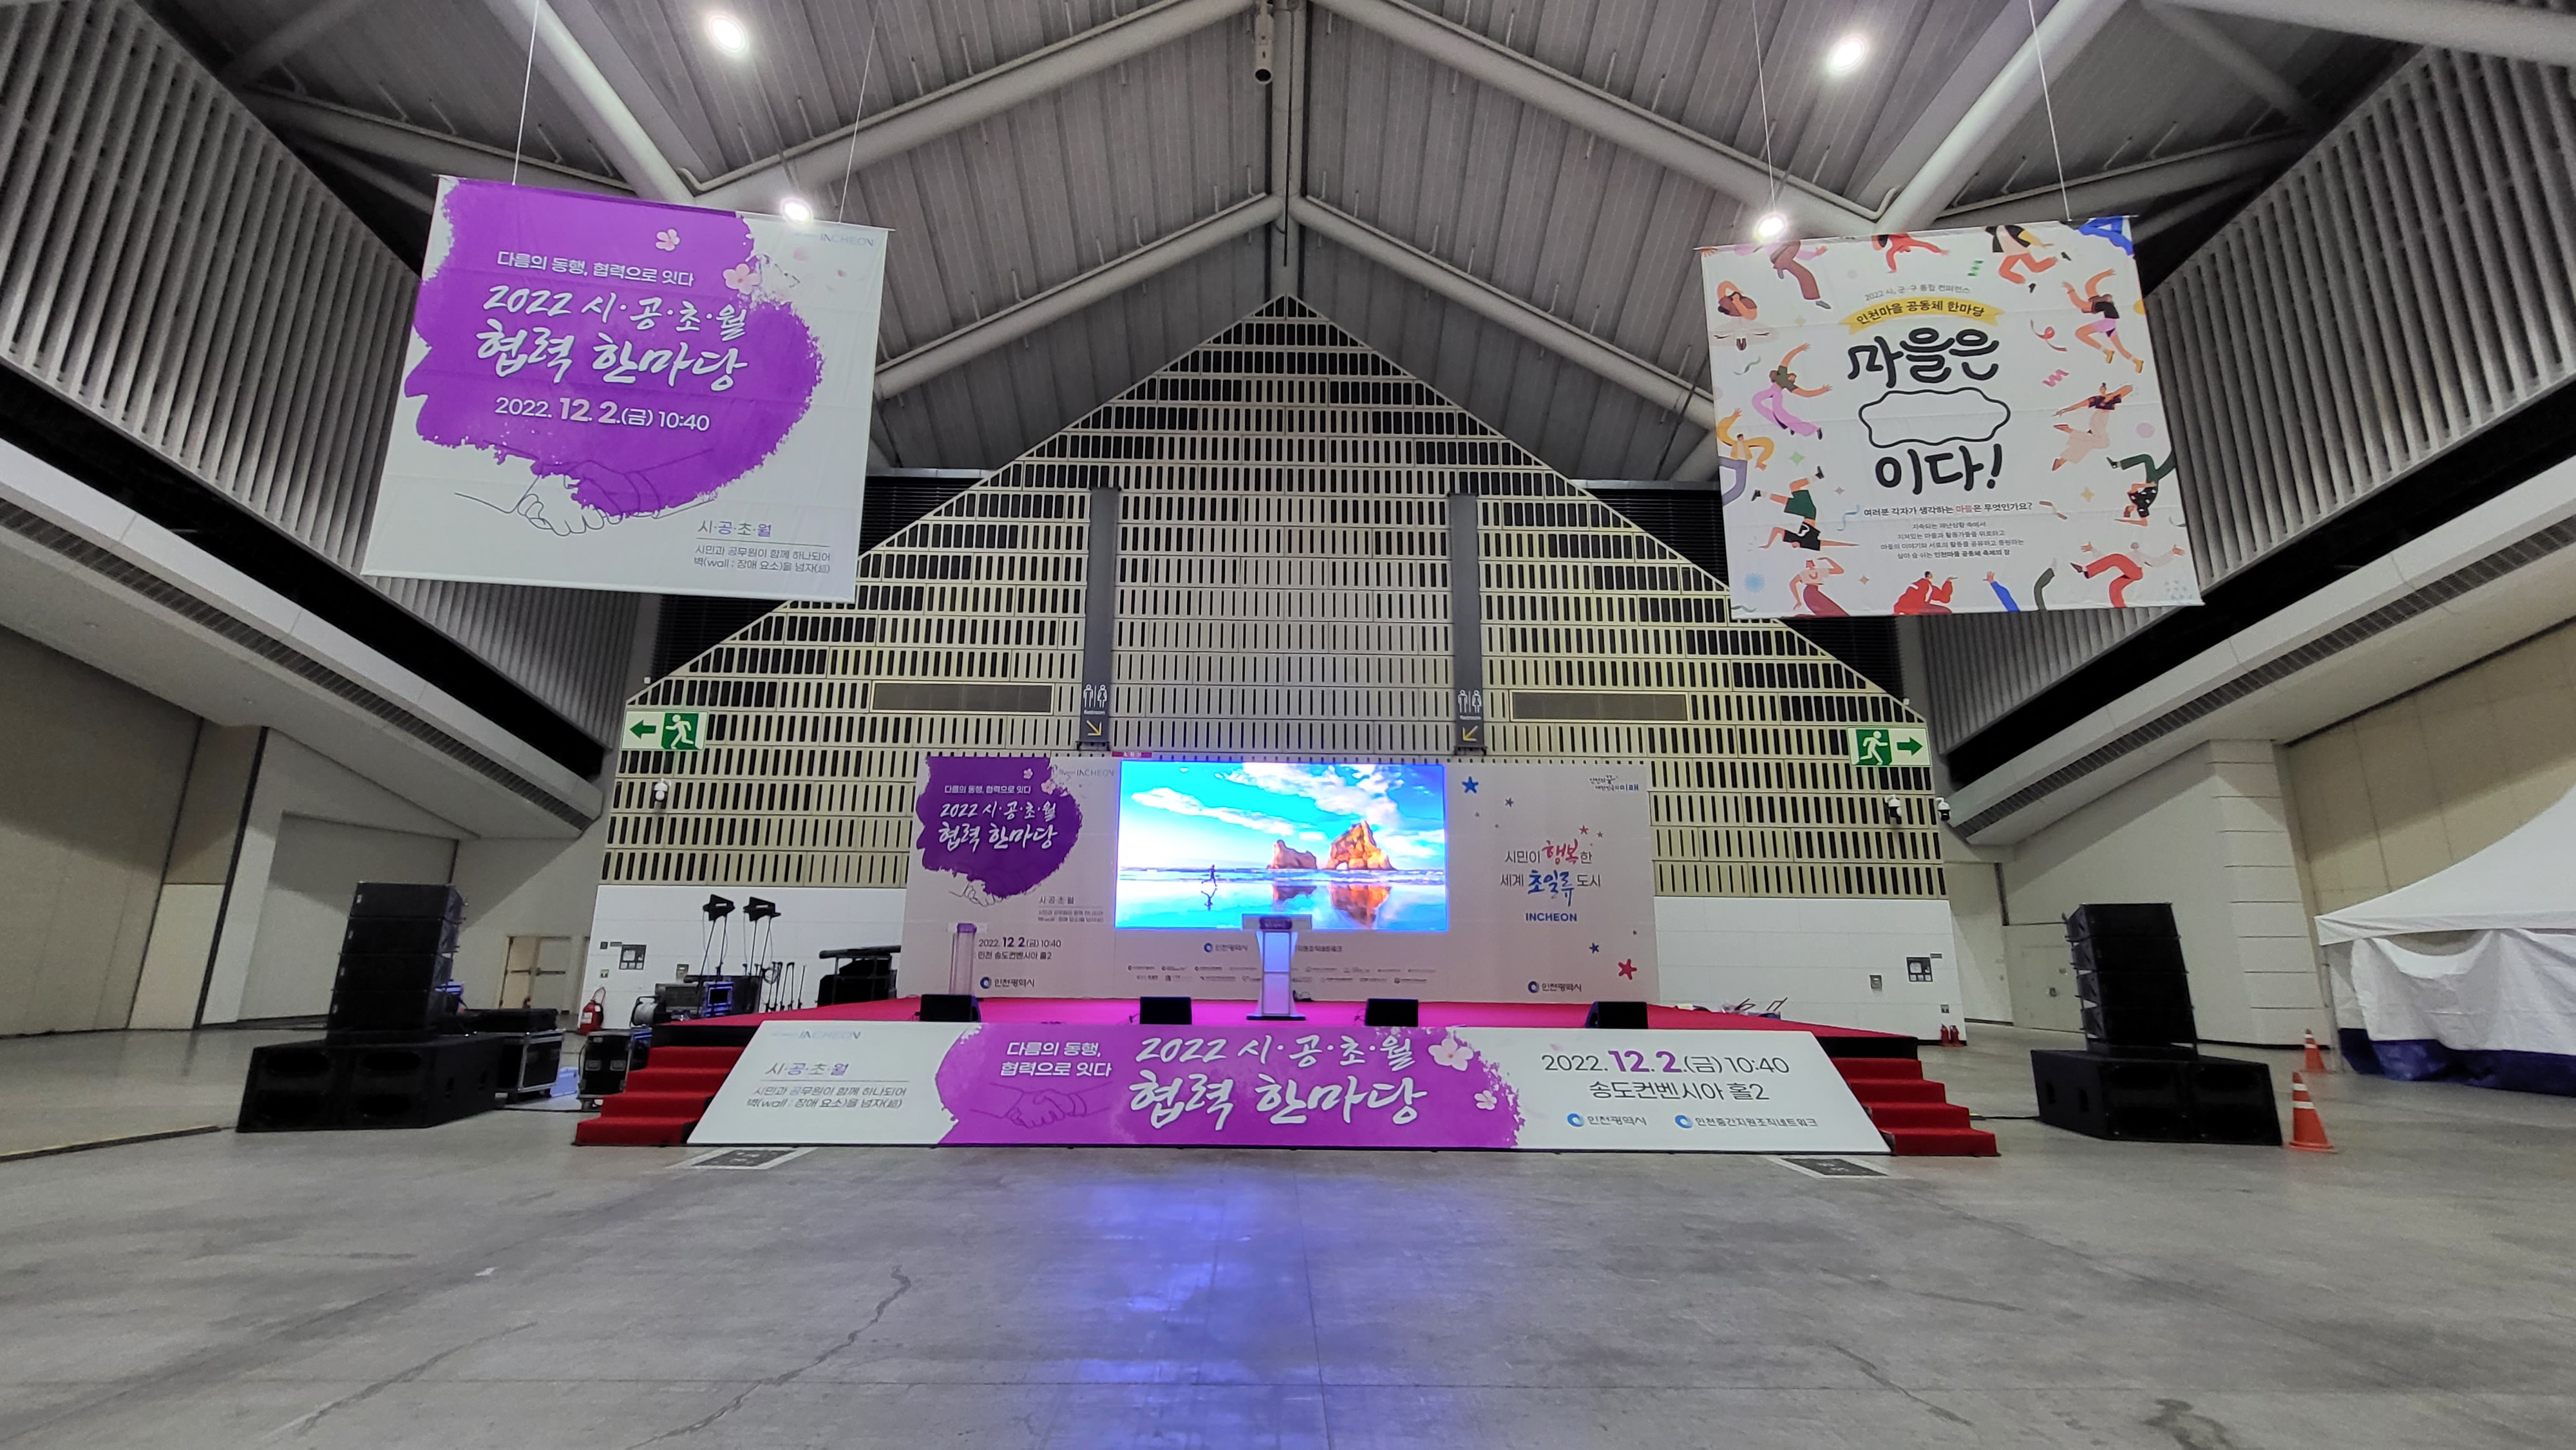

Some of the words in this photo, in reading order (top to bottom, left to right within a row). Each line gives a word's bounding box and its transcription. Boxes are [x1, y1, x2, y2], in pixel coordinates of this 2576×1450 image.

[820, 233, 874, 247] INCHEON
[497, 250, 547, 270] 다름의
[551, 258, 588, 276] 동행,
[592, 262, 657, 283] 협력으로
[661, 270, 694, 287] 잇다
[482, 285, 573, 317] 2022
[1857, 303, 1903, 325] 인천마을
[1906, 299, 1943, 312] 공동체
[1947, 301, 1985, 317] 한마당
[475, 318, 575, 384] 협력
[591, 332, 748, 391] 한마당
[1848, 327, 2000, 388] 마을은
[494, 397, 553, 418] 2022.
[559, 397, 592, 422] 12.
[658, 411, 710, 431] 10:40
[1875, 443, 2002, 495] 이다!
[1863, 507, 1889, 517] 여러분
[1891, 506, 1917, 516] 각자가
[1919, 505, 1954, 515] 생각하는
[1956, 504, 1982, 514] 마을은
[1984, 502, 2032, 512] 무엇인가요?
[696, 545, 725, 556] 시민과
[728, 547, 767, 558] 공무원이
[770, 549, 790, 560] 함께
[792, 551, 831, 561] 하나되어
[737, 560, 757, 569] 장애
[940, 803, 978, 818] 2022
[938, 821, 981, 852] 협력
[989, 822, 1058, 849] 한마당
[1505, 851, 1540, 863] 시민이
[1501, 874, 1524, 887] 세계
[1528, 869, 1575, 907] 초일류
[1577, 874, 1601, 887] 도시
[1526, 912, 1577, 921] INCHEON
[1041, 939, 1061, 948] 10:40
[994, 979, 1035, 988] 인천광역시
[1542, 983, 1582, 992] 인천광역시
[1007, 1041, 1059, 1056] 다름의
[1064, 1042, 1101, 1057] 동행,
[1135, 1038, 1227, 1063] 2022
[1001, 1062, 1072, 1077] 협력으로
[1076, 1062, 1113, 1077] 잇다
[1541, 1055, 1608, 1072] 2022.
[1608, 1050, 1655, 1073] 12.
[1724, 1057, 1790, 1073] 10:40
[753, 1087, 788, 1096] 시민과
[790, 1086, 834, 1096] 공무원이
[837, 1087, 860, 1096] 함께
[862, 1087, 907, 1096] 하나되어
[1589, 1080, 1725, 1100] 송도컨벤시아
[1727, 1082, 1770, 1100] 홀2
[795, 1098, 818, 1108] 장애
[1129, 1069, 1234, 1131] 협력
[1255, 1073, 1428, 1125] 한마당
[1587, 1116, 1647, 1126] 인천광역시
[1695, 1117, 1819, 1127] 인천중간지원조직네트워크
